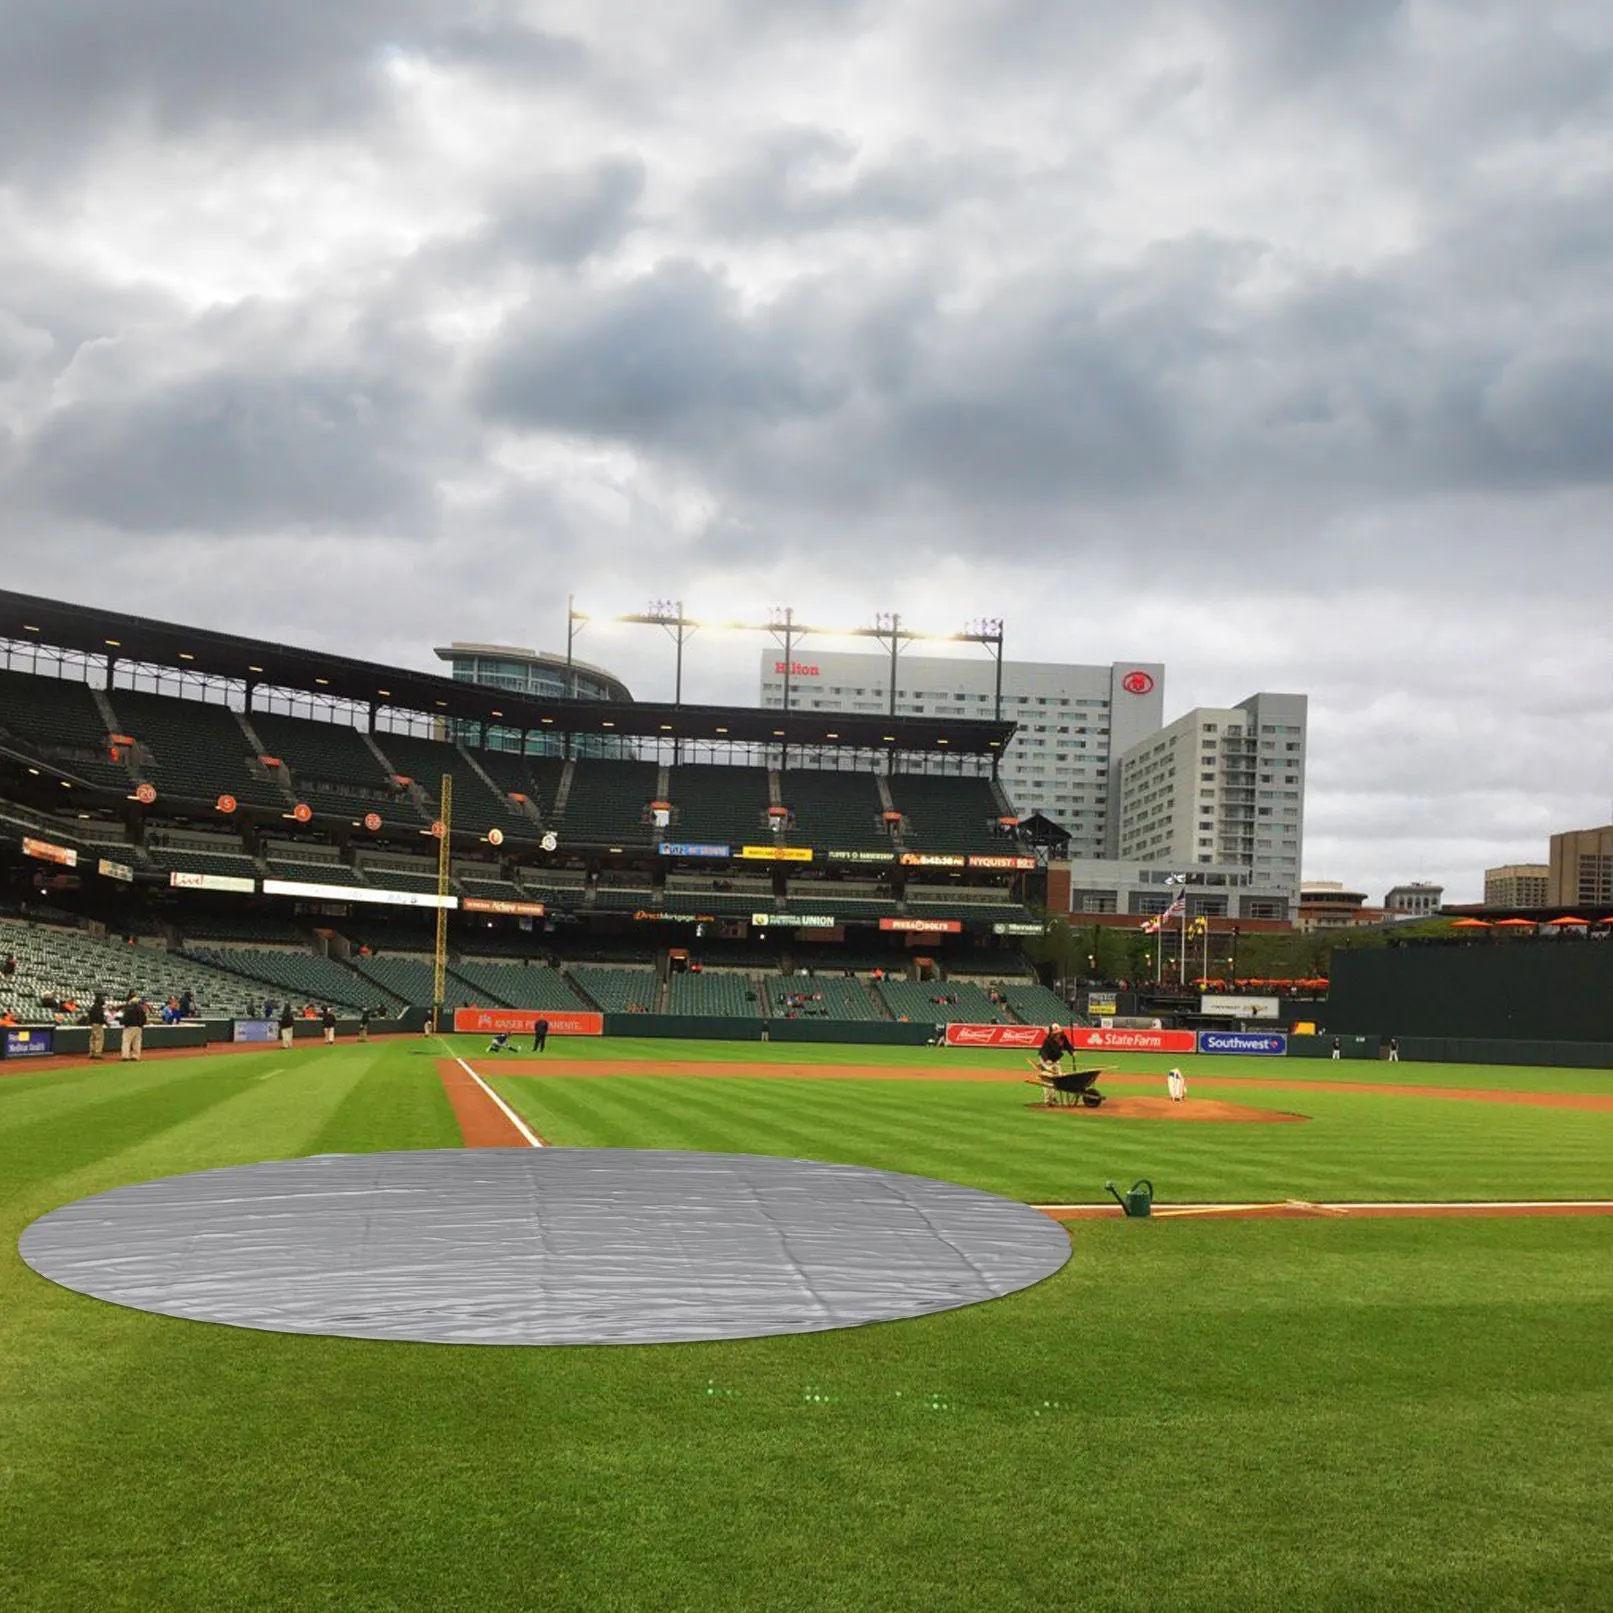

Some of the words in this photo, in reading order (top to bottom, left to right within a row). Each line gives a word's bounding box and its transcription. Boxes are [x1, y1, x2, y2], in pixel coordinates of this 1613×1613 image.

[775, 661, 820, 676] Hlton
[802, 915, 835, 927] UNION
[495, 1019, 523, 1028] KAISER
[1207, 1036, 1270, 1050] Southwest
